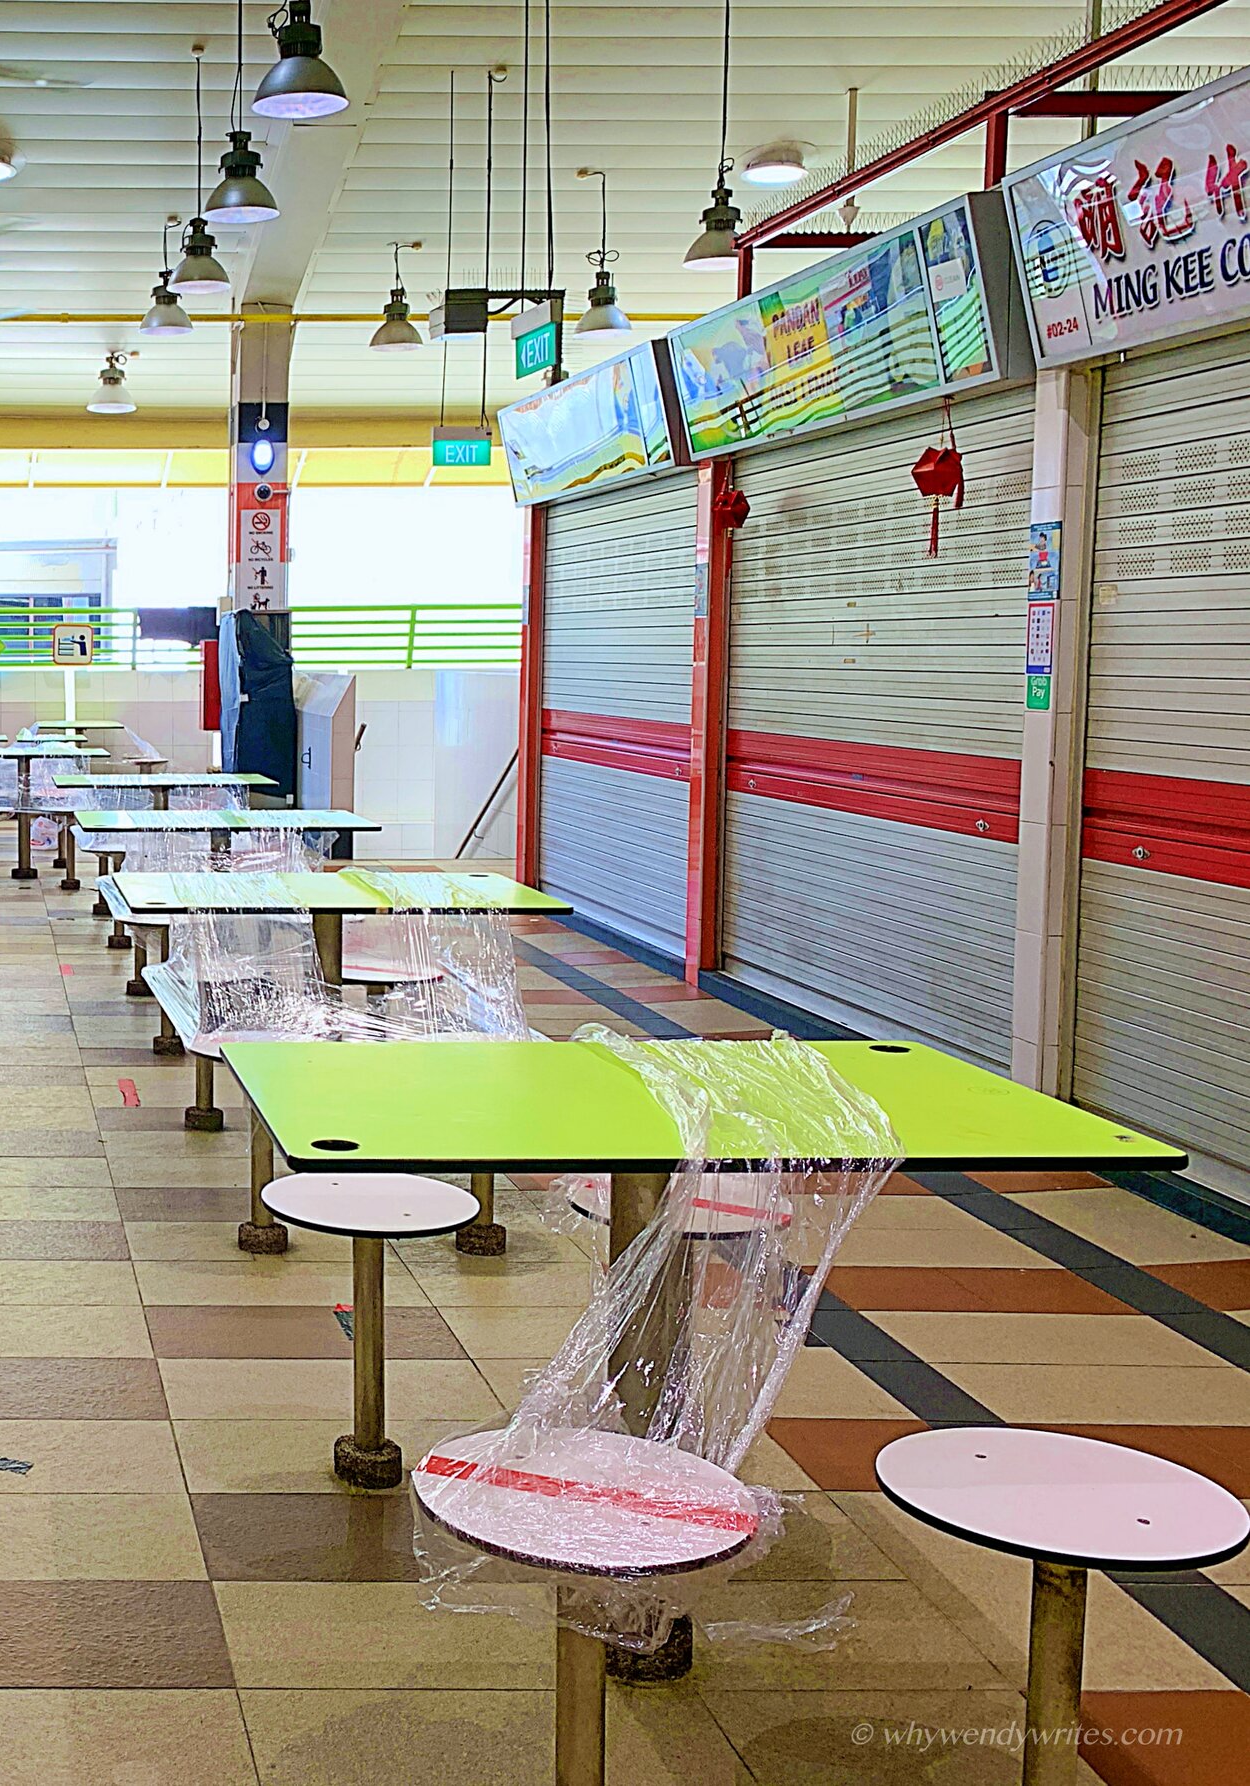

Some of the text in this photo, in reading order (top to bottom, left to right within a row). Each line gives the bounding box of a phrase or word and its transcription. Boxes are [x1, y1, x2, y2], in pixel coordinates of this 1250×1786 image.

[1093, 263, 1158, 320] MING
[1163, 246, 1214, 300] KEE
[772, 297, 821, 339] PANDAN
[1046, 317, 1079, 339] #02-24
[527, 332, 550, 368] EXIT
[786, 336, 815, 365] LEAF
[445, 444, 478, 463] EXIT
[1030, 676, 1048, 687] Grab
[1031, 686, 1045, 699] Pay
